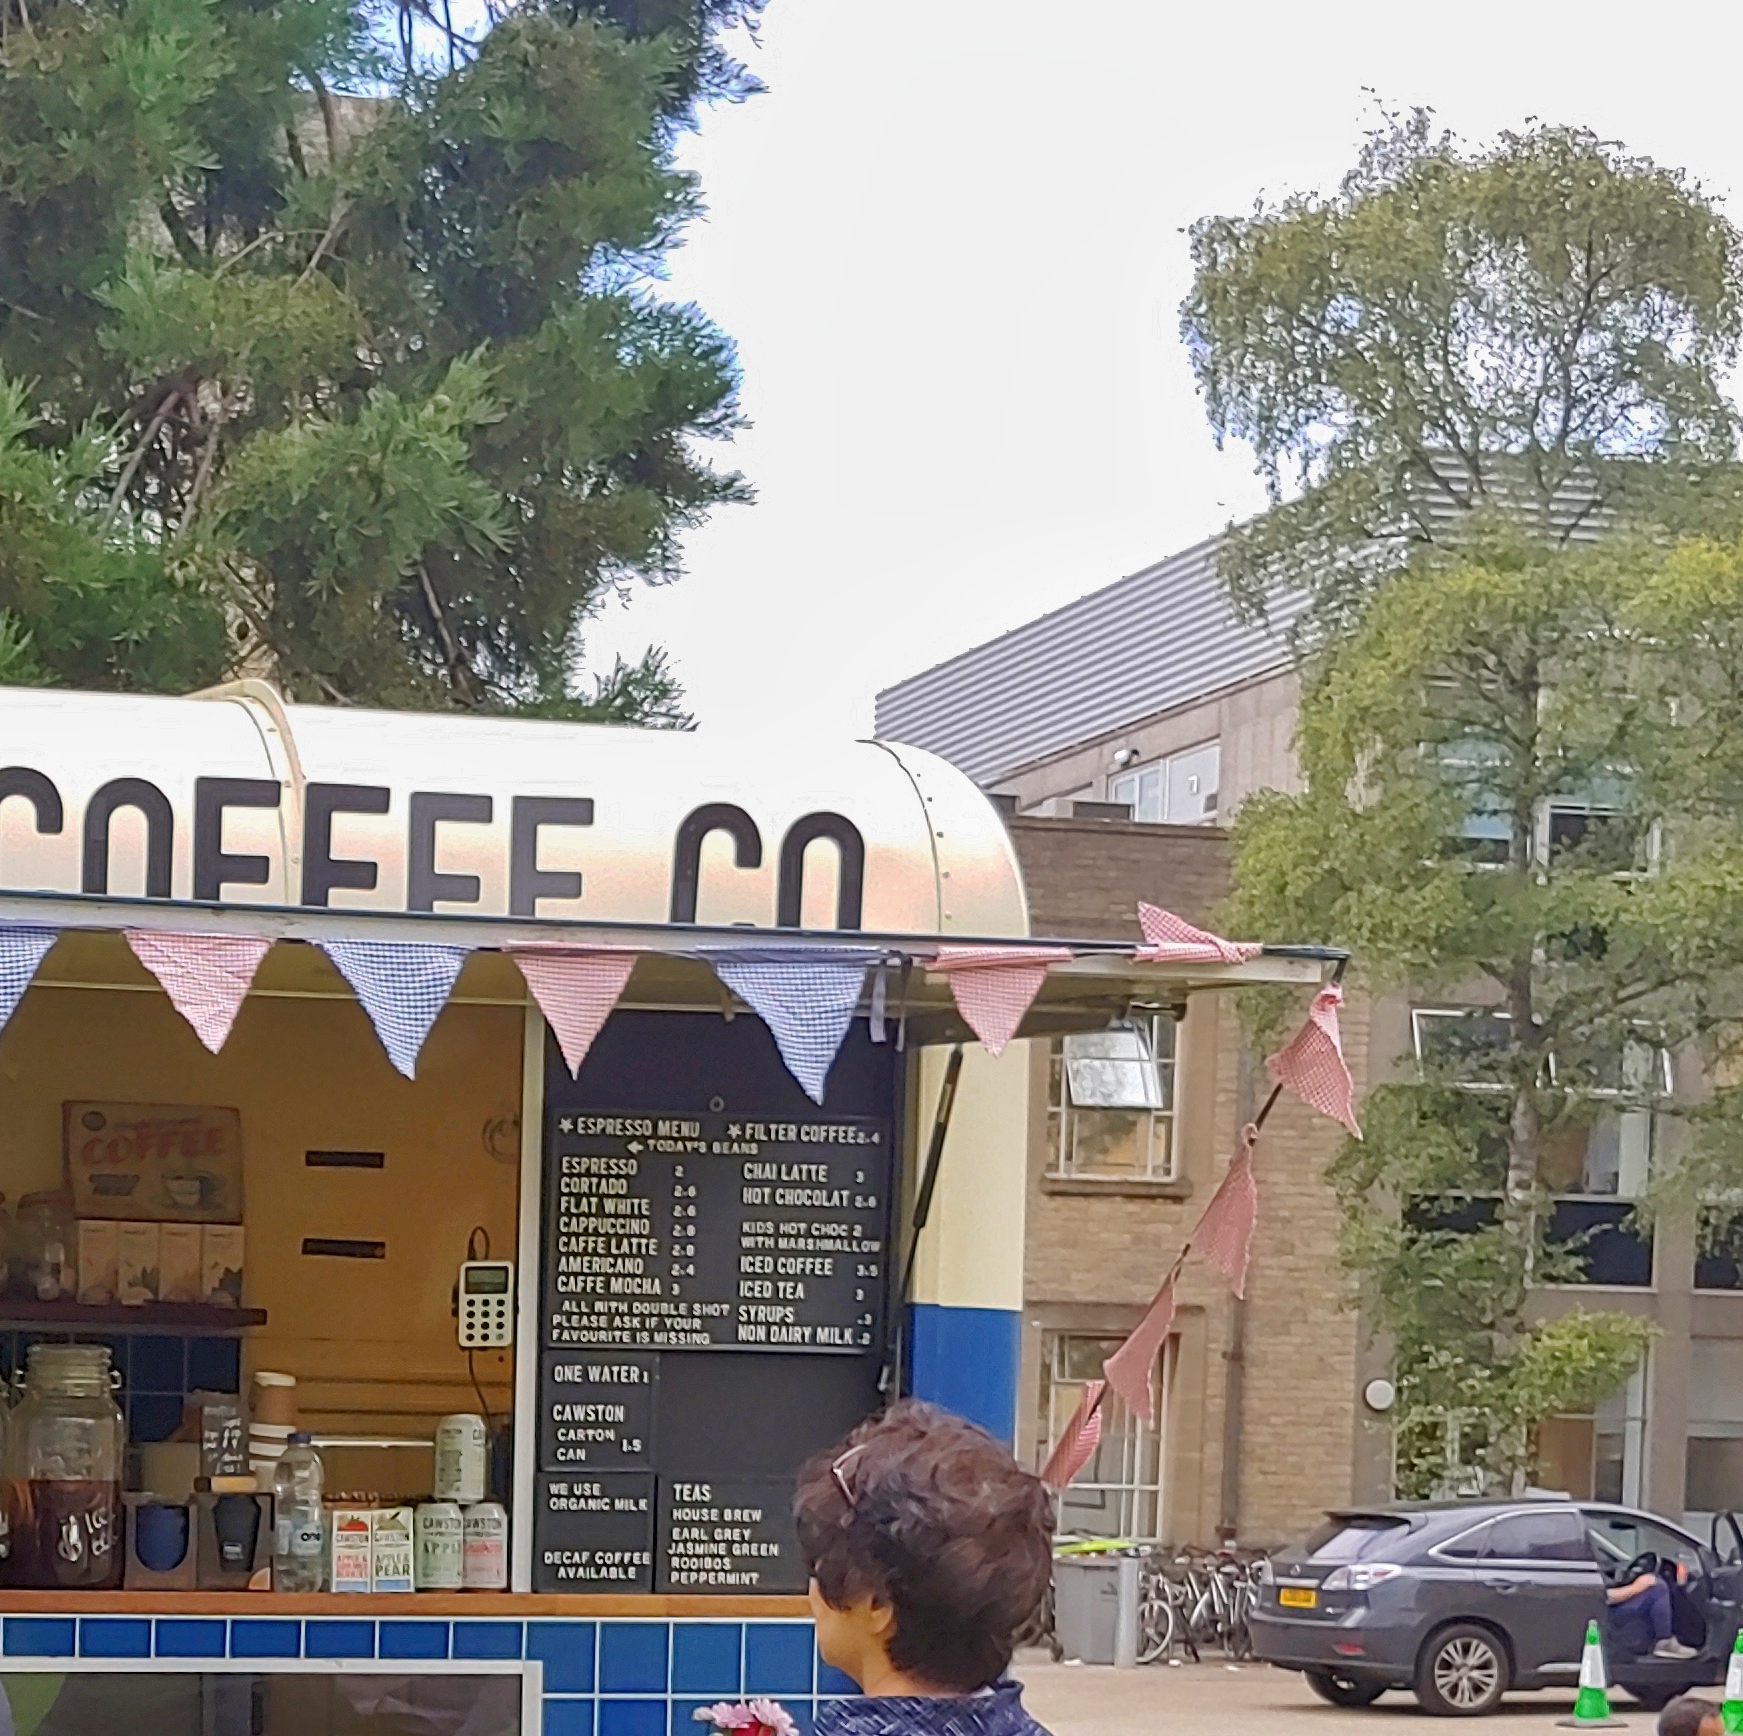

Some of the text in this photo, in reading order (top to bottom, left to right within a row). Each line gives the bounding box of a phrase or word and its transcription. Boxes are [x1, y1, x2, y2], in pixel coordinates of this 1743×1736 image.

[577, 1117, 700, 1138] ESPRESSO MENU
[745, 1123, 798, 1141] FILTER
[800, 1124, 857, 1144] COFFEE
[647, 1139, 759, 1155] TODAY'S BEANS
[562, 1156, 638, 1175] ESPRESSO
[743, 1162, 778, 1180] CHAI
[780, 1163, 828, 1183] LATTE
[560, 1177, 628, 1194] CORTADO
[742, 1186, 850, 1207] HOT CHOCOLAT
[560, 1196, 651, 1216] FLAT WHITE
[559, 1217, 650, 1236] CAPPUCCINO
[742, 1221, 774, 1234] KIDS
[779, 1222, 808, 1235] HOT
[811, 1222, 848, 1236] CHOC
[558, 1236, 659, 1255] CAFFE LATTE
[741, 1236, 881, 1252] WITH MARSHMALLOW
[558, 1255, 645, 1275] AMERICANO
[740, 1255, 774, 1273] ICED
[777, 1257, 834, 1275] COFFEE
[557, 1275, 606, 1293] CAFFE
[610, 1277, 662, 1295] MOCHA
[739, 1280, 773, 1298] ICED
[777, 1281, 805, 1299] TEA
[562, 1300, 730, 1316] ALL WITH DOUBLE SHOT
[738, 1305, 794, 1323] SYRUPS
[552, 1314, 702, 1330] PLEASE ASK IF YOUR
[552, 1329, 710, 1345] FAVOURITE IS MISSING
[738, 1323, 854, 1345] NON DAIRY MILK
[554, 1365, 583, 1384] ONE
[588, 1365, 640, 1384] WATER
[553, 1404, 624, 1422] CAWSTON
[557, 1428, 615, 1443] CARTON
[557, 1447, 586, 1462] CAN
[549, 1483, 601, 1497] WE USE
[673, 1484, 712, 1502] TEAS
[550, 1498, 648, 1511] ORGANIC MILK
[672, 1508, 762, 1522] HOUSE BREW
[672, 1528, 751, 1542] EARL GREY
[667, 1542, 780, 1557] JASMINE GREEN
[544, 1552, 651, 1565] DECAF COFFEE
[671, 1557, 732, 1571] ROOIBOS
[558, 1566, 636, 1580] AVAILABLE
[670, 1572, 759, 1586] PEPPERMINT
